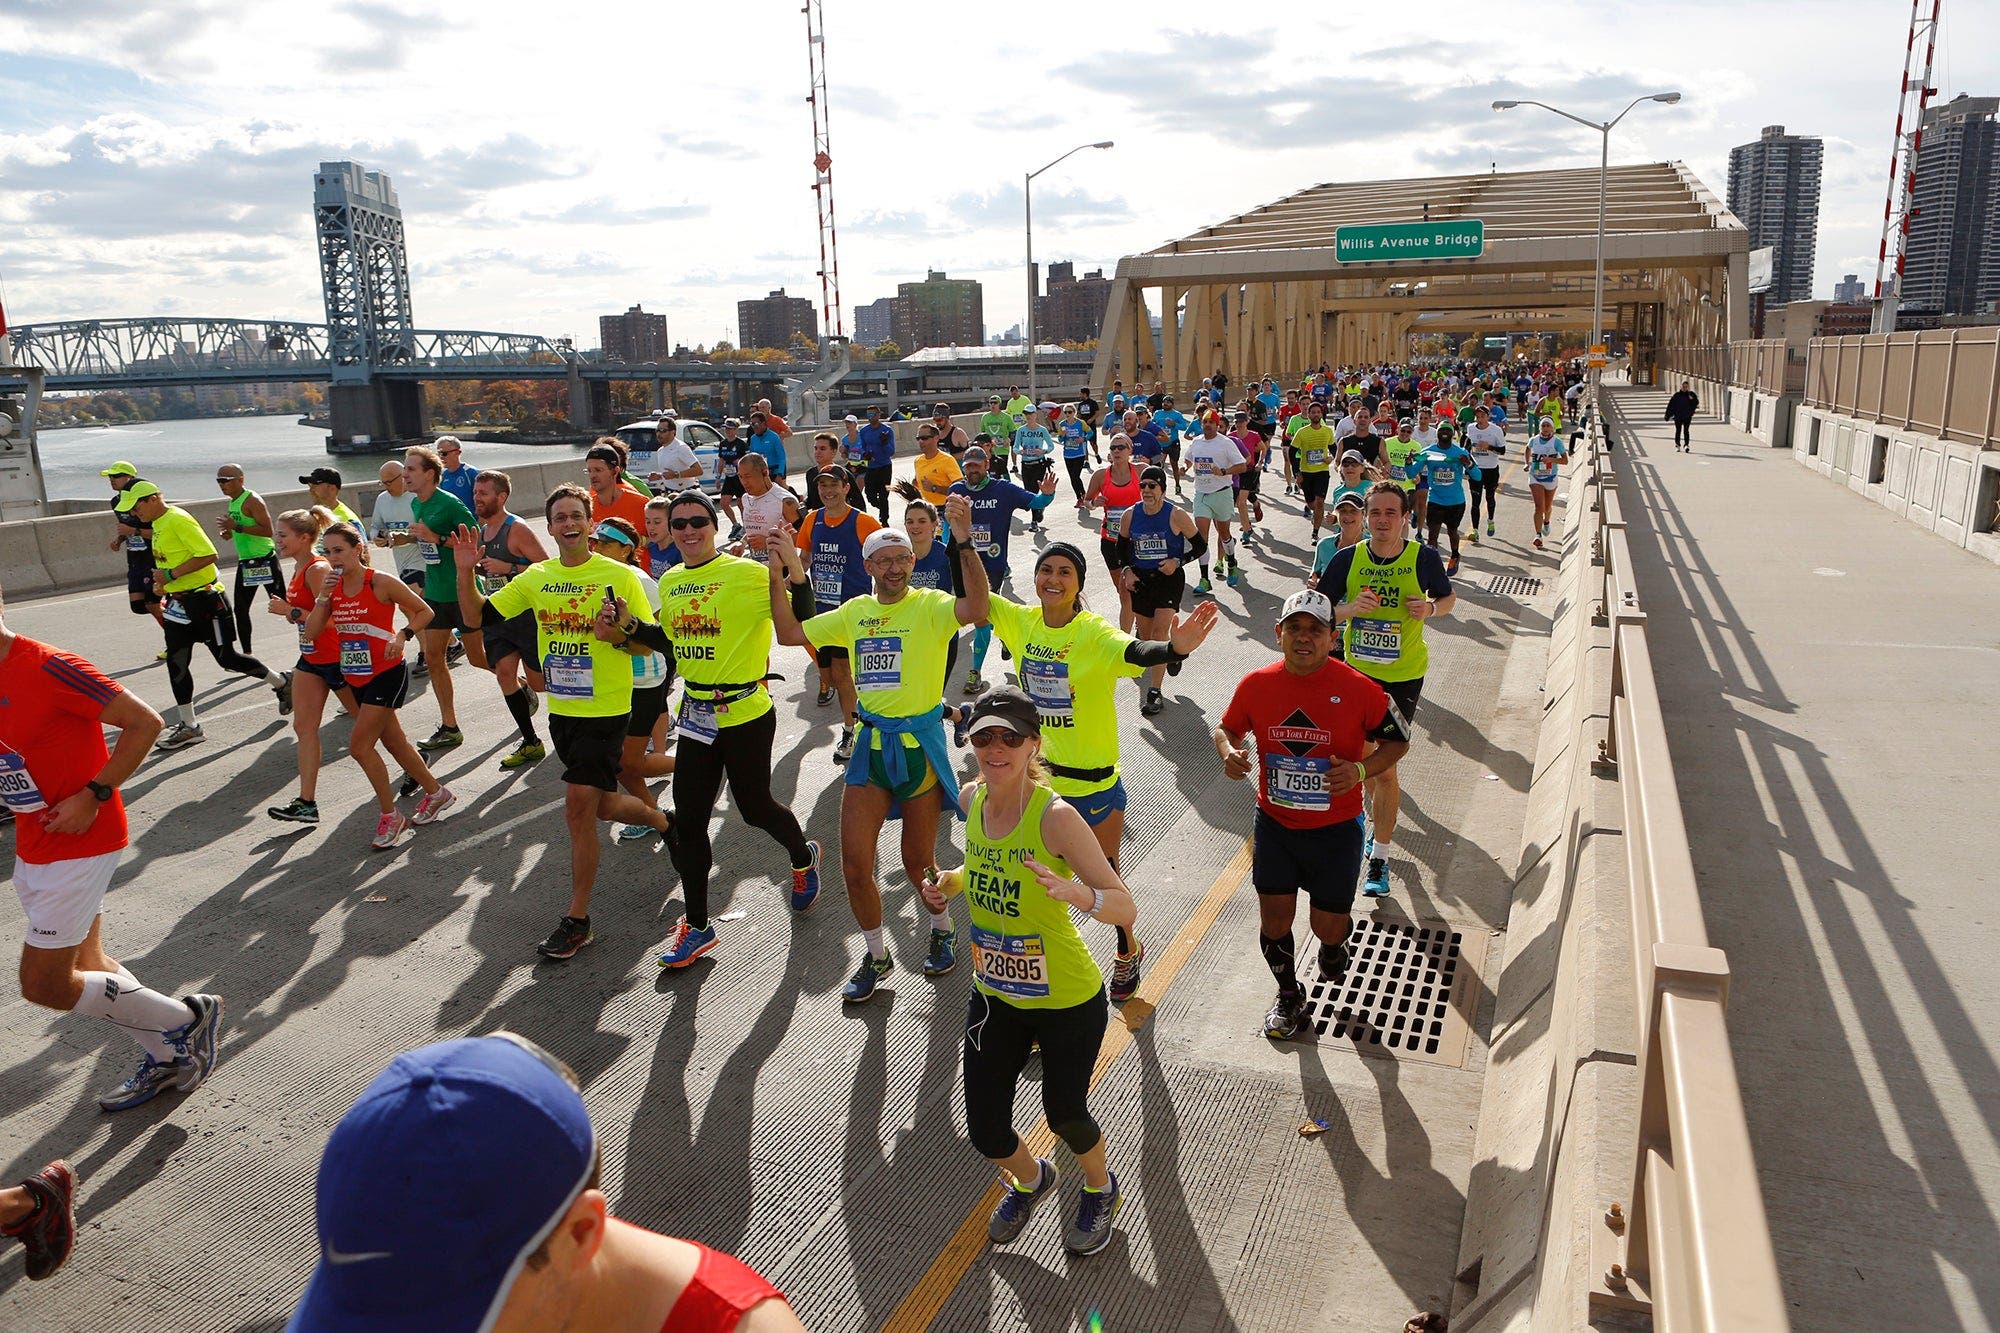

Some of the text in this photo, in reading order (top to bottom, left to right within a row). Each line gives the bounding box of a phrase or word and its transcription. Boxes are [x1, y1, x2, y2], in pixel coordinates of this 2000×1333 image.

[1340, 233, 1479, 250] Willis Avenue Bridge
[974, 499, 998, 509] CAMP
[819, 543, 839, 552] TEAM
[1143, 541, 1163, 549] 21071
[1359, 567, 1412, 577] CONNOR'S DAD
[541, 582, 584, 593] Achilles
[669, 583, 706, 597] Achilles
[817, 581, 838, 593] 24179
[356, 608, 368, 616] End
[1363, 632, 1397, 648] 33799
[549, 643, 589, 656] GUIDE
[675, 645, 715, 660] GUIDE
[1025, 643, 1061, 659] Achilles
[345, 651, 369, 664] 35483
[863, 654, 896, 671] 18937
[1039, 715, 1074, 728] UIDE
[1286, 730, 1302, 739] YORK
[1304, 731, 1328, 742] FLYERS
[0, 773, 30, 792] 896
[1285, 773, 1321, 790] 7599
[966, 839, 1003, 863] SYLVIE'S
[969, 869, 1021, 900] TEAM
[975, 892, 1021, 918] KIDS
[984, 952, 1042, 981] 28695
